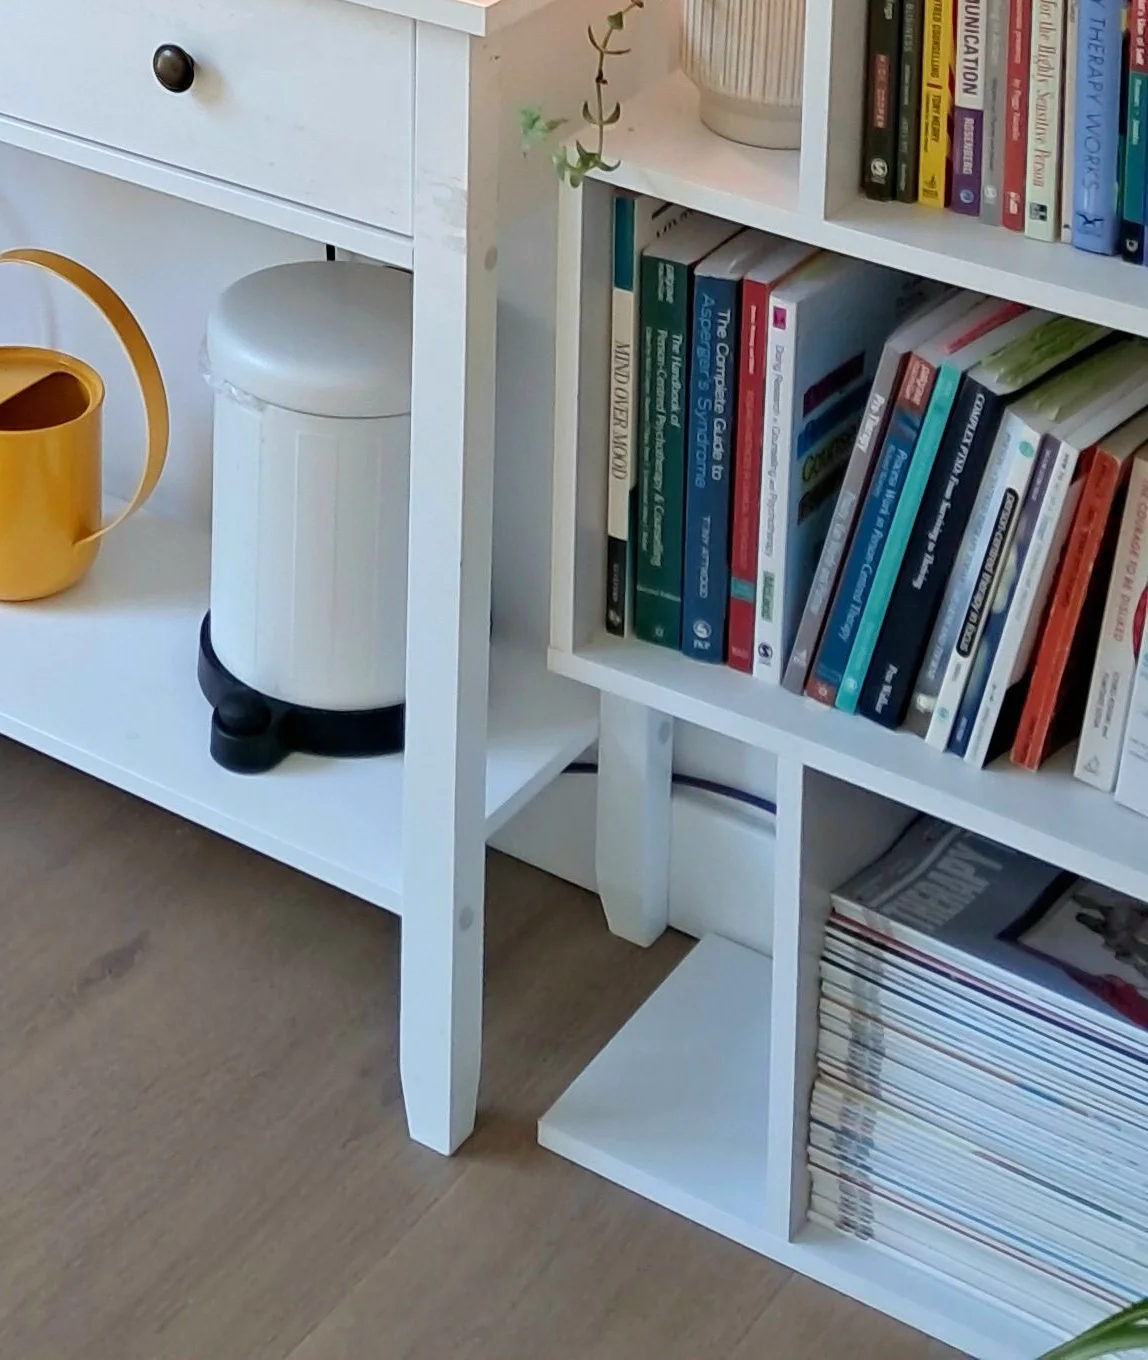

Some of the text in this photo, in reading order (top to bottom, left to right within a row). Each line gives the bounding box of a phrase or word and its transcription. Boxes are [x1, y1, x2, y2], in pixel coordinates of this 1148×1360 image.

[902, 2, 914, 52] BUSINESS
[1039, 0, 1058, 17] for
[1039, 21, 1057, 40] the
[1031, 44, 1055, 83] Highly
[1085, 17, 1105, 106] THERAPY
[1033, 90, 1052, 144] Sensitive
[961, 117, 975, 175] ROSENBERG
[1031, 149, 1051, 187] Person
[1082, 113, 1102, 190] WORKS
[653, 329, 668, 411] Person-Centred
[669, 333, 682, 428] The Handbook of
[692, 293, 715, 489] Asperger's Syndrome
[710, 308, 730, 479] The Complete Guide to
[611, 340, 629, 479] MIND OVER MOOD
[961, 391, 986, 445] COMPLEX
[652, 413, 666, 491] Psychotherapy
[878, 487, 896, 515] Work
[926, 497, 951, 541] Surviving
[649, 504, 664, 566] Counselling
[1127, 501, 1148, 558] COURAGE
[958, 490, 1017, 652] person-centred therapy in focus
[1121, 575, 1134, 590] BE
[1125, 559, 1137, 575] TO
[836, 601, 861, 643] Therapy
[1111, 592, 1132, 643] DISLIKED
